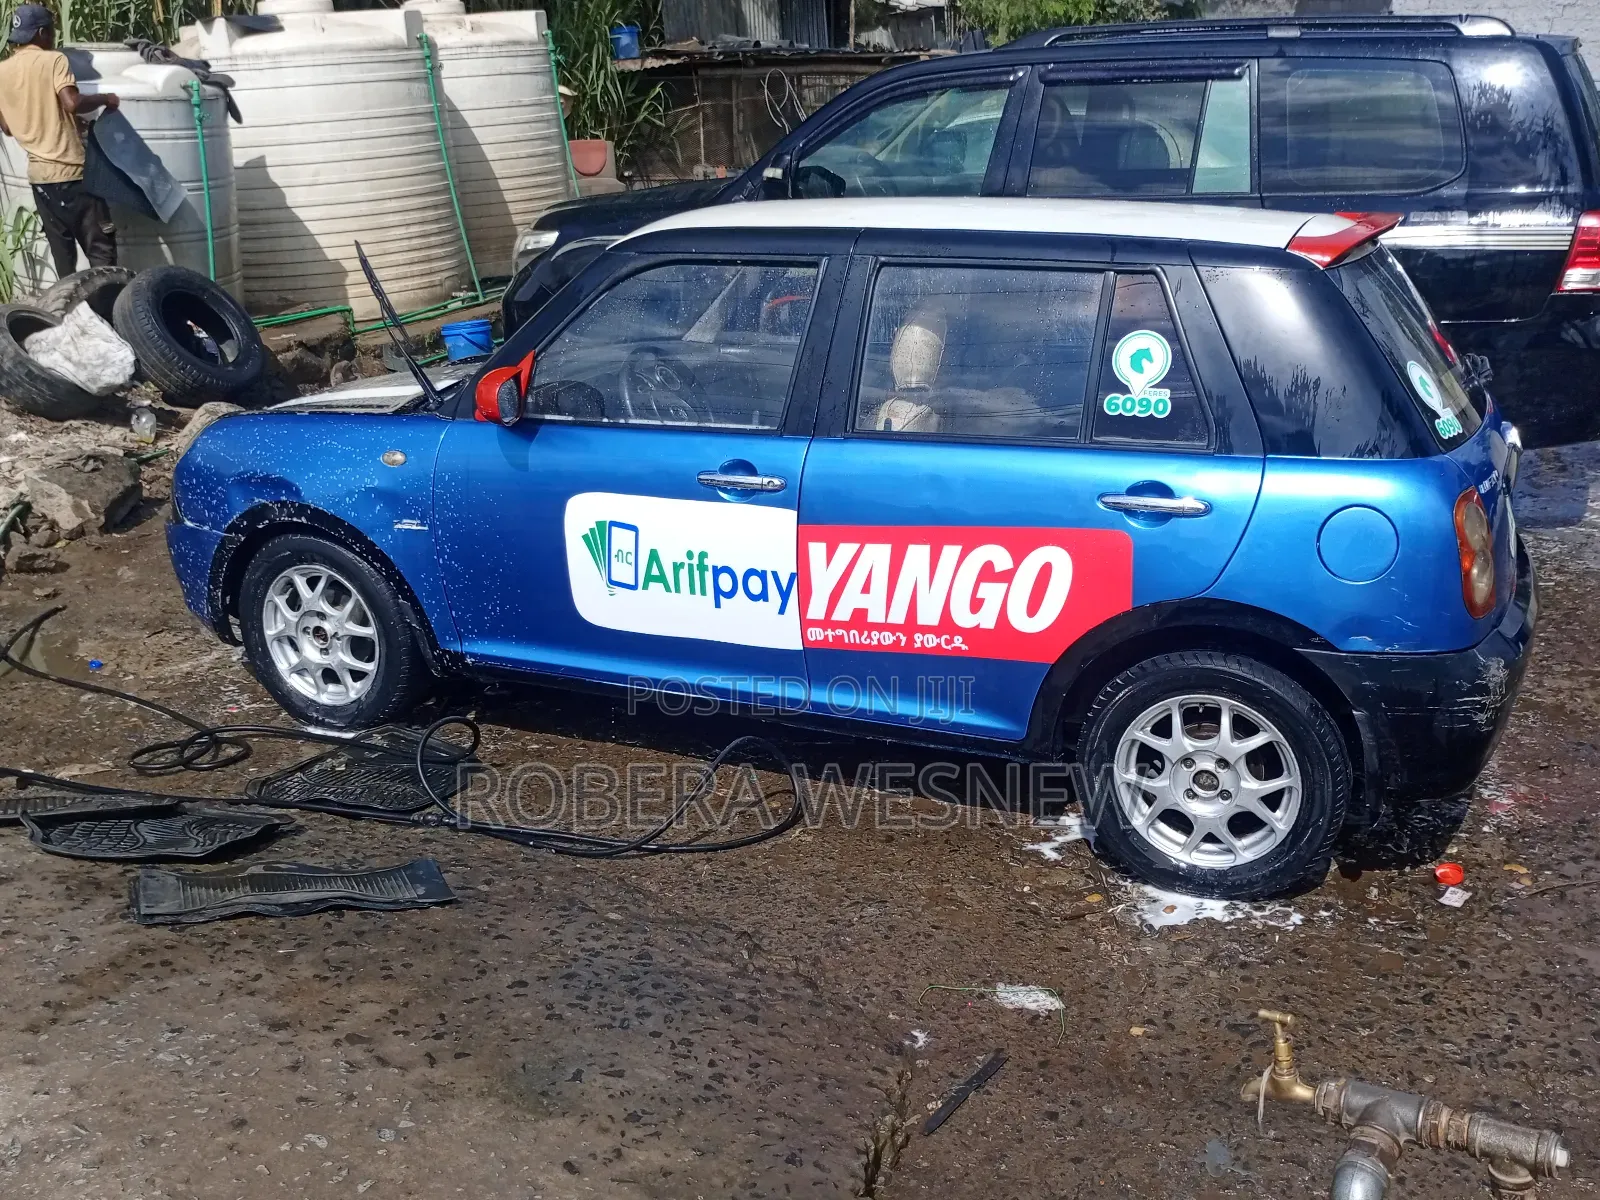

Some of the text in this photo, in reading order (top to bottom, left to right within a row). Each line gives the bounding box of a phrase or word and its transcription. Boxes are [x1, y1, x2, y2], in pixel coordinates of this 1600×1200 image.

[1105, 395, 1169, 416] 6090
[1436, 416, 1461, 438] 6090
[642, 548, 798, 616] Arifpay
[806, 541, 1074, 634] YANGO
[806, 627, 969, 651] መተግበሪያውን ያውርዱ
